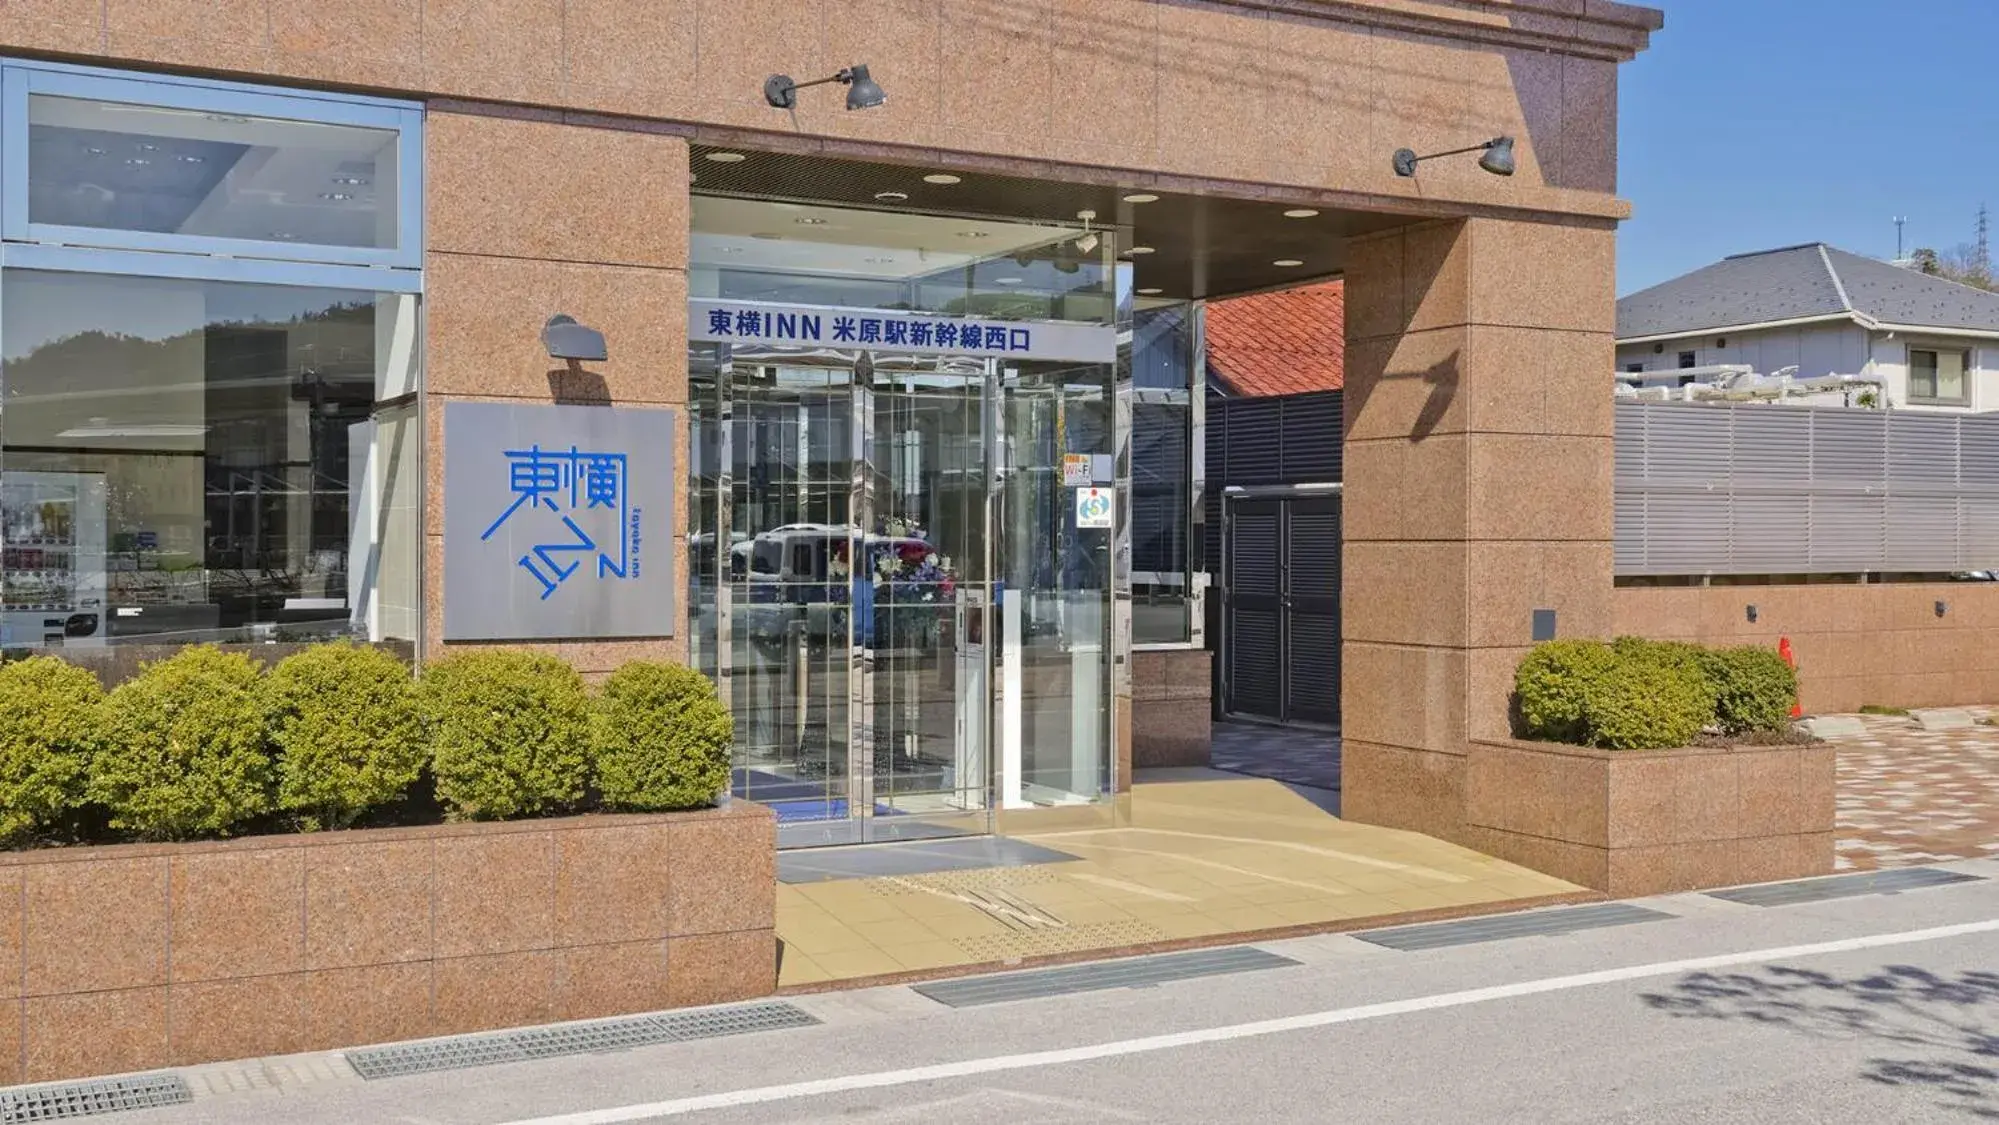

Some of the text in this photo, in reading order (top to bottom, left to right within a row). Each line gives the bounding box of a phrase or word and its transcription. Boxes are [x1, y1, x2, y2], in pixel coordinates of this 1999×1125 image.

[708, 309, 1031, 351] 東横INN 米原駅新幹線西口
